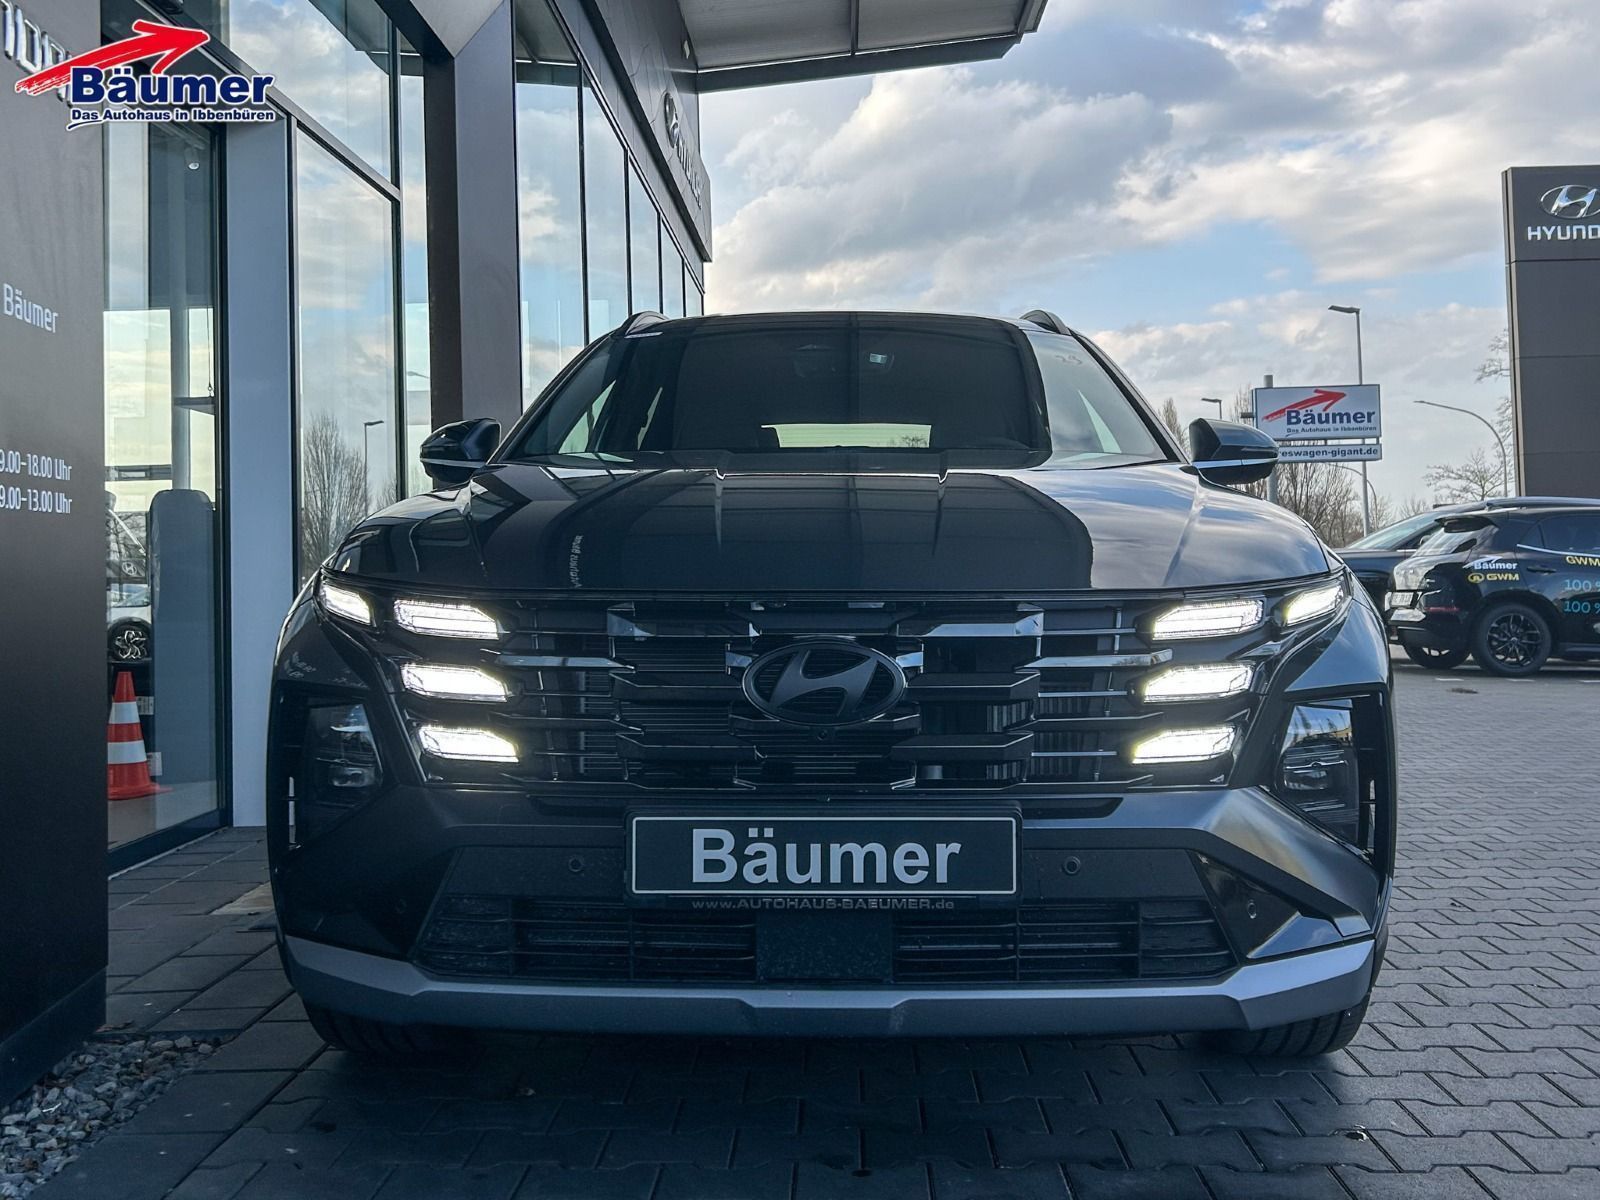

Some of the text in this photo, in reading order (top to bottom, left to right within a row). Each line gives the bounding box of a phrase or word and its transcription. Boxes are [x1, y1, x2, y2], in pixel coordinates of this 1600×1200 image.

[1527, 225, 1600, 240] HYUND
[3, 283, 59, 333] Bäumer
[1286, 409, 1376, 425] Bäumer
[55, 458, 72, 480] Uhr
[55, 492, 72, 514] Uhr
[1566, 555, 1600, 567] GWM
[1486, 573, 1520, 581] GWM
[1564, 579, 1592, 592] 100
[1563, 601, 1591, 614] 100
[692, 827, 962, 884] Bäumer
[691, 898, 955, 910] www.AUTOHAUS-BAEUMER.de
